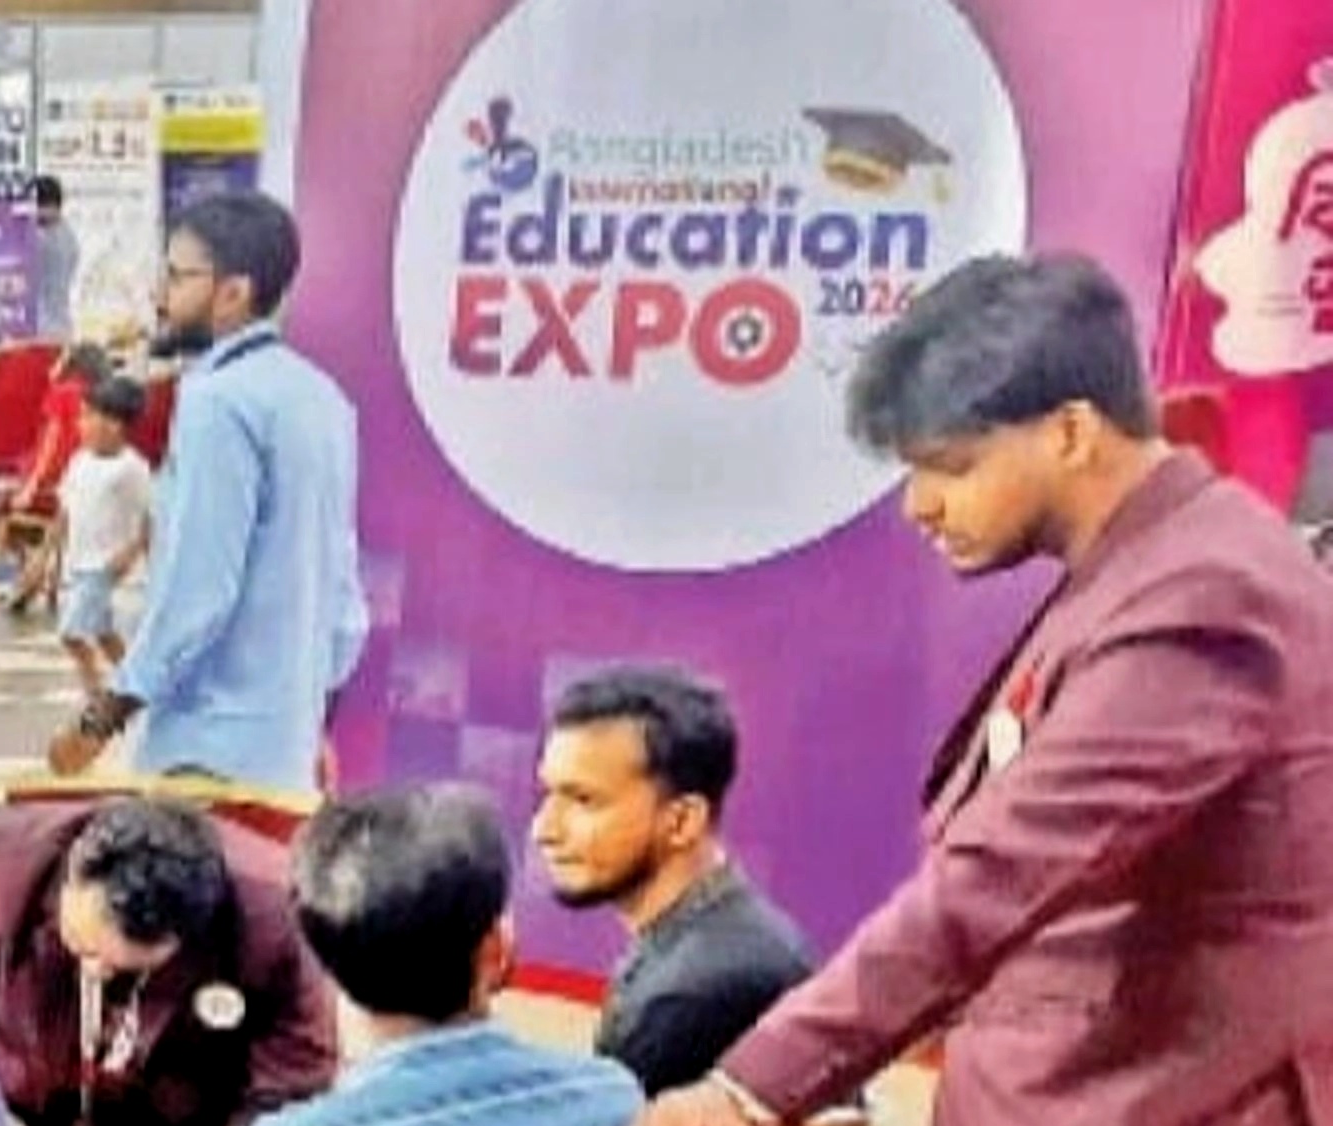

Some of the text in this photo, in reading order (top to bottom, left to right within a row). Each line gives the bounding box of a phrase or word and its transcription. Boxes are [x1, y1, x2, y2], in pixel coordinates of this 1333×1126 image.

[550, 126, 811, 178] Bangladesh
[567, 172, 772, 205] International
[460, 173, 930, 270] Education
[815, 279, 915, 317] 2026
[449, 276, 802, 387] EXPO
